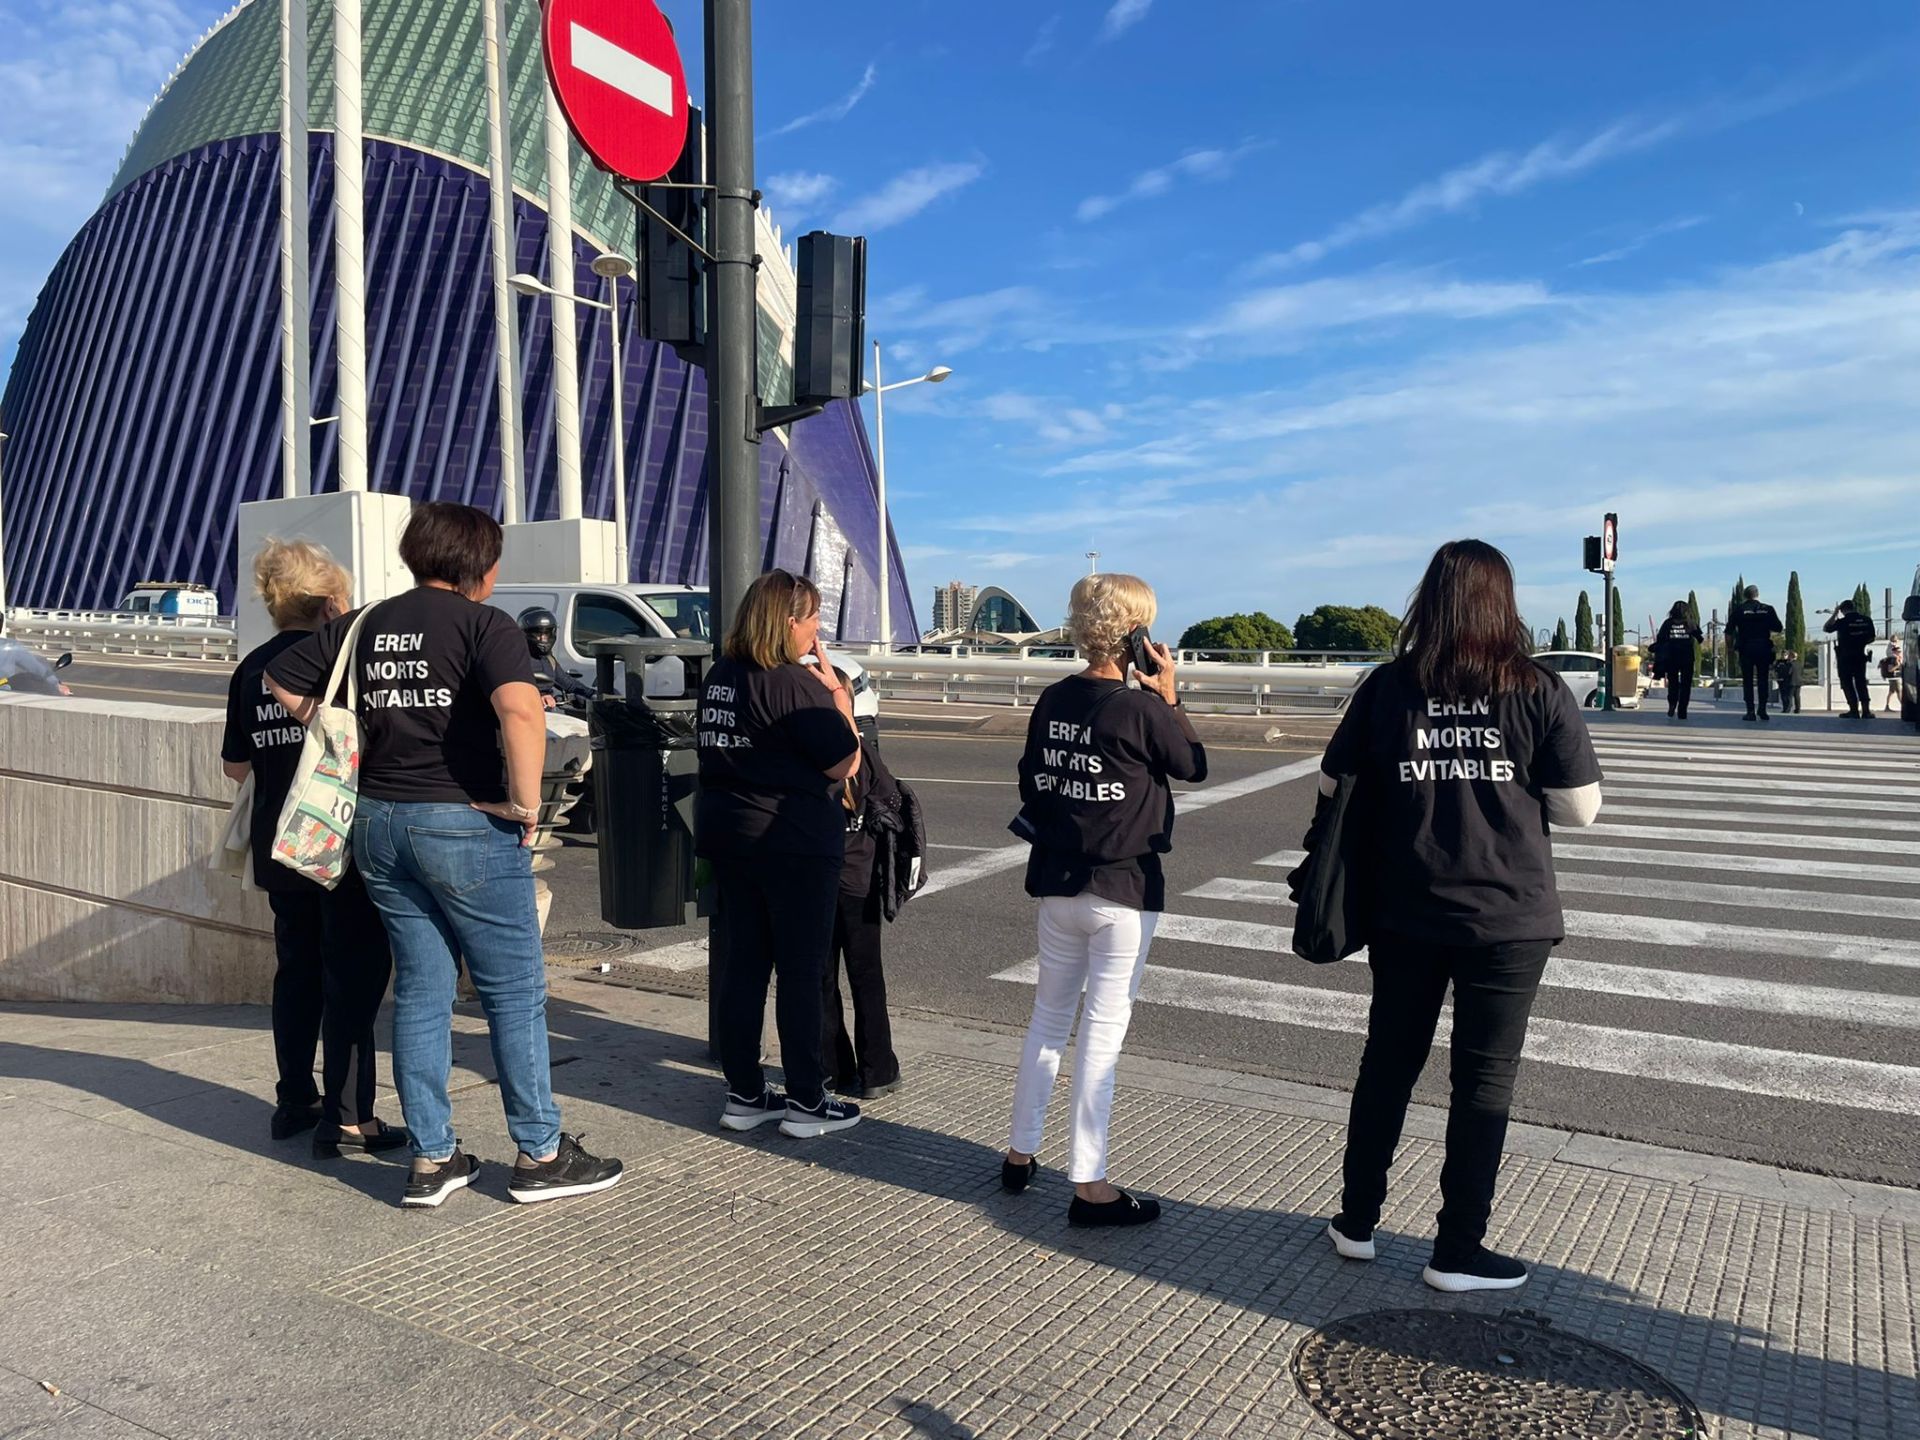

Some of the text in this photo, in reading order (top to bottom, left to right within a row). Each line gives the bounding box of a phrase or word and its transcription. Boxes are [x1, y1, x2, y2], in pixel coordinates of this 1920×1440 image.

[373, 633, 424, 652] EREN
[365, 660, 429, 681] MORTS
[706, 684, 736, 703] EREN
[1416, 726, 1501, 750] MORTS
[1398, 758, 1516, 782] EVITABLES
